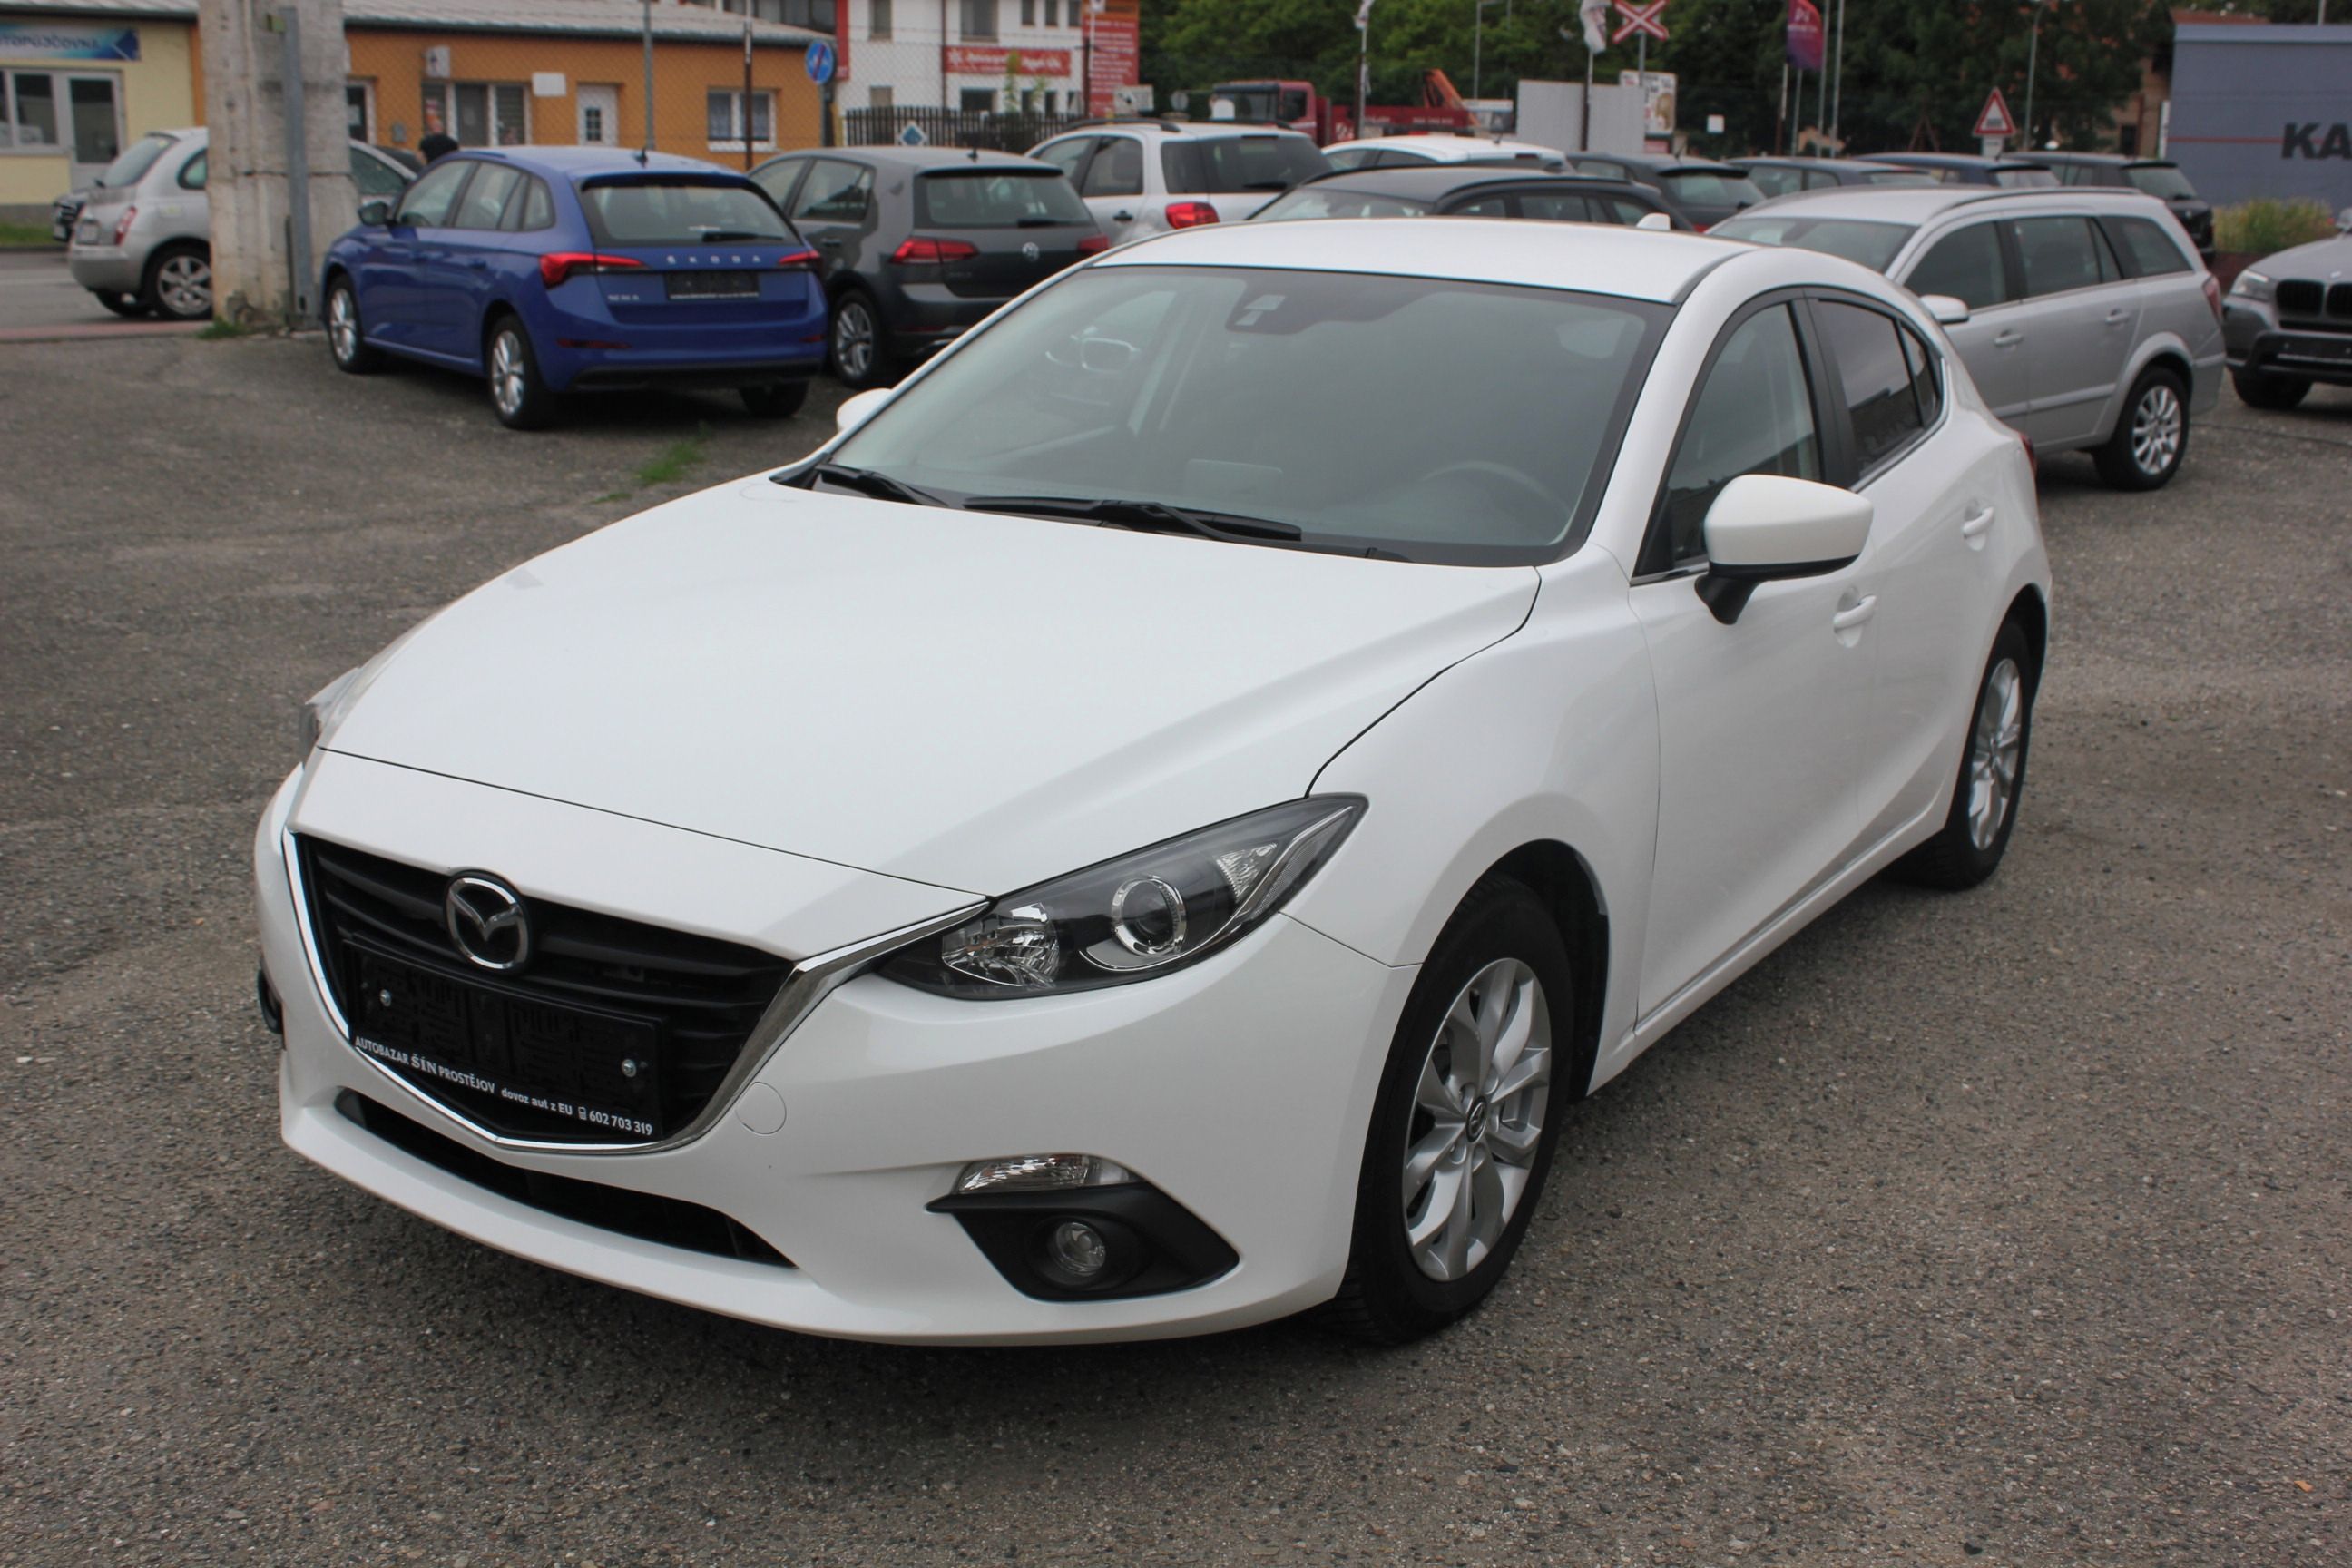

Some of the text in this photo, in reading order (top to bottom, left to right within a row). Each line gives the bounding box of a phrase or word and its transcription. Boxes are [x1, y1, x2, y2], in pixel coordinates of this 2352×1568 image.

[355, 1036, 408, 1065] AUTOBAZAR
[438, 1065, 495, 1093] PROSTĚJOV
[501, 1088, 529, 1104] dovoz
[532, 1098, 548, 1109] aut
[551, 1102, 556, 1112] z
[558, 1102, 573, 1116] EU
[589, 1111, 610, 1126] 602
[611, 1115, 632, 1132] 703
[633, 1121, 652, 1136] 319
